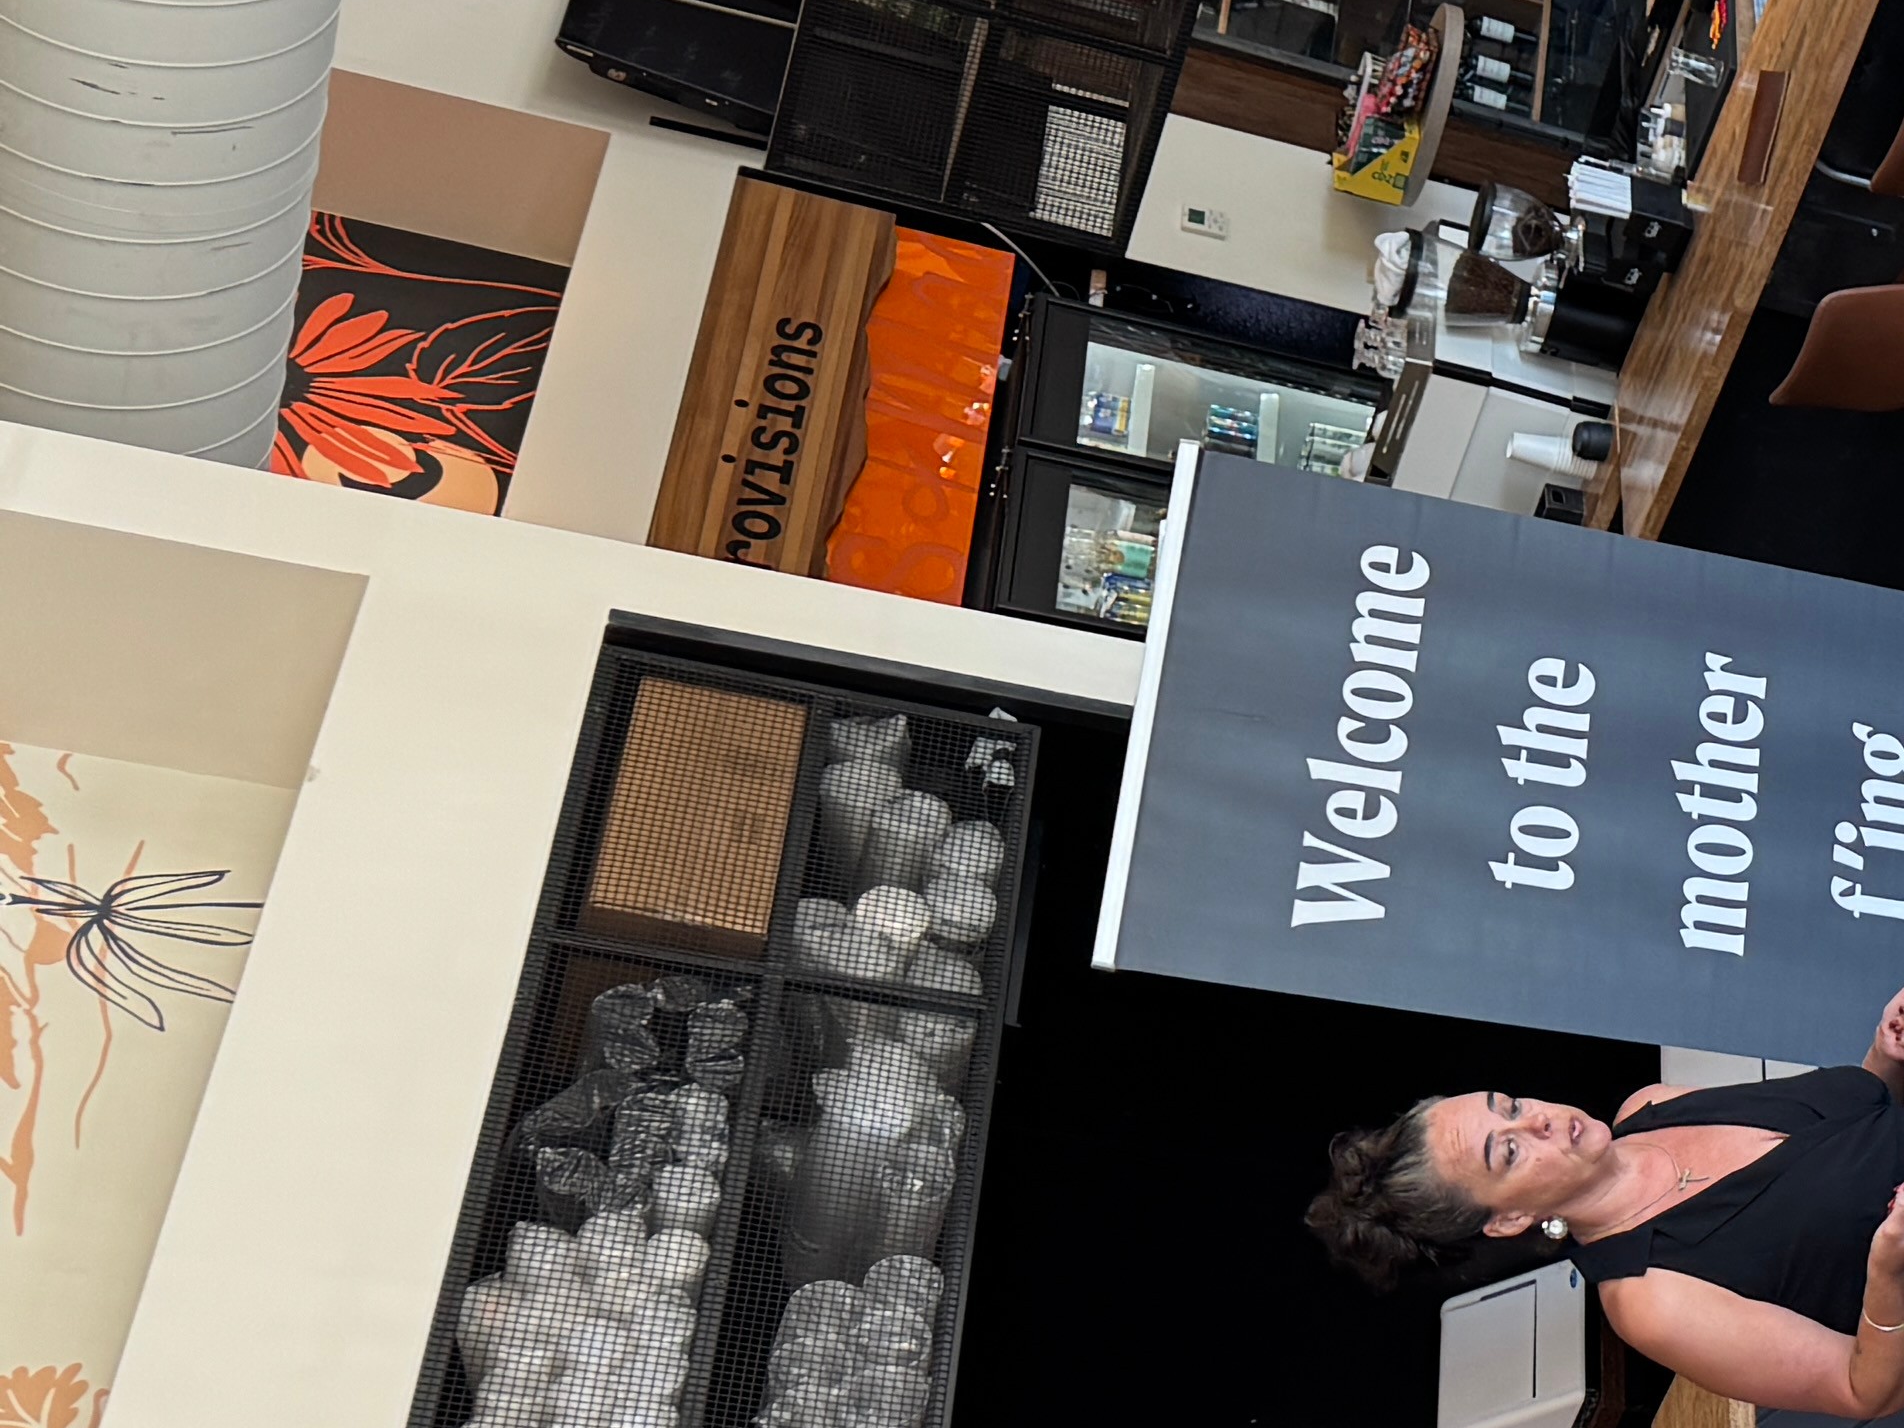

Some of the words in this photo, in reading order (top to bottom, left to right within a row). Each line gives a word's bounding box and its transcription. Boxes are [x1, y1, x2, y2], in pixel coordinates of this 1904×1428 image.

[1291, 545, 1433, 928] Welcome
[1496, 658, 1595, 786] the
[1671, 652, 1766, 956] mother
[1488, 806, 1579, 890] to
